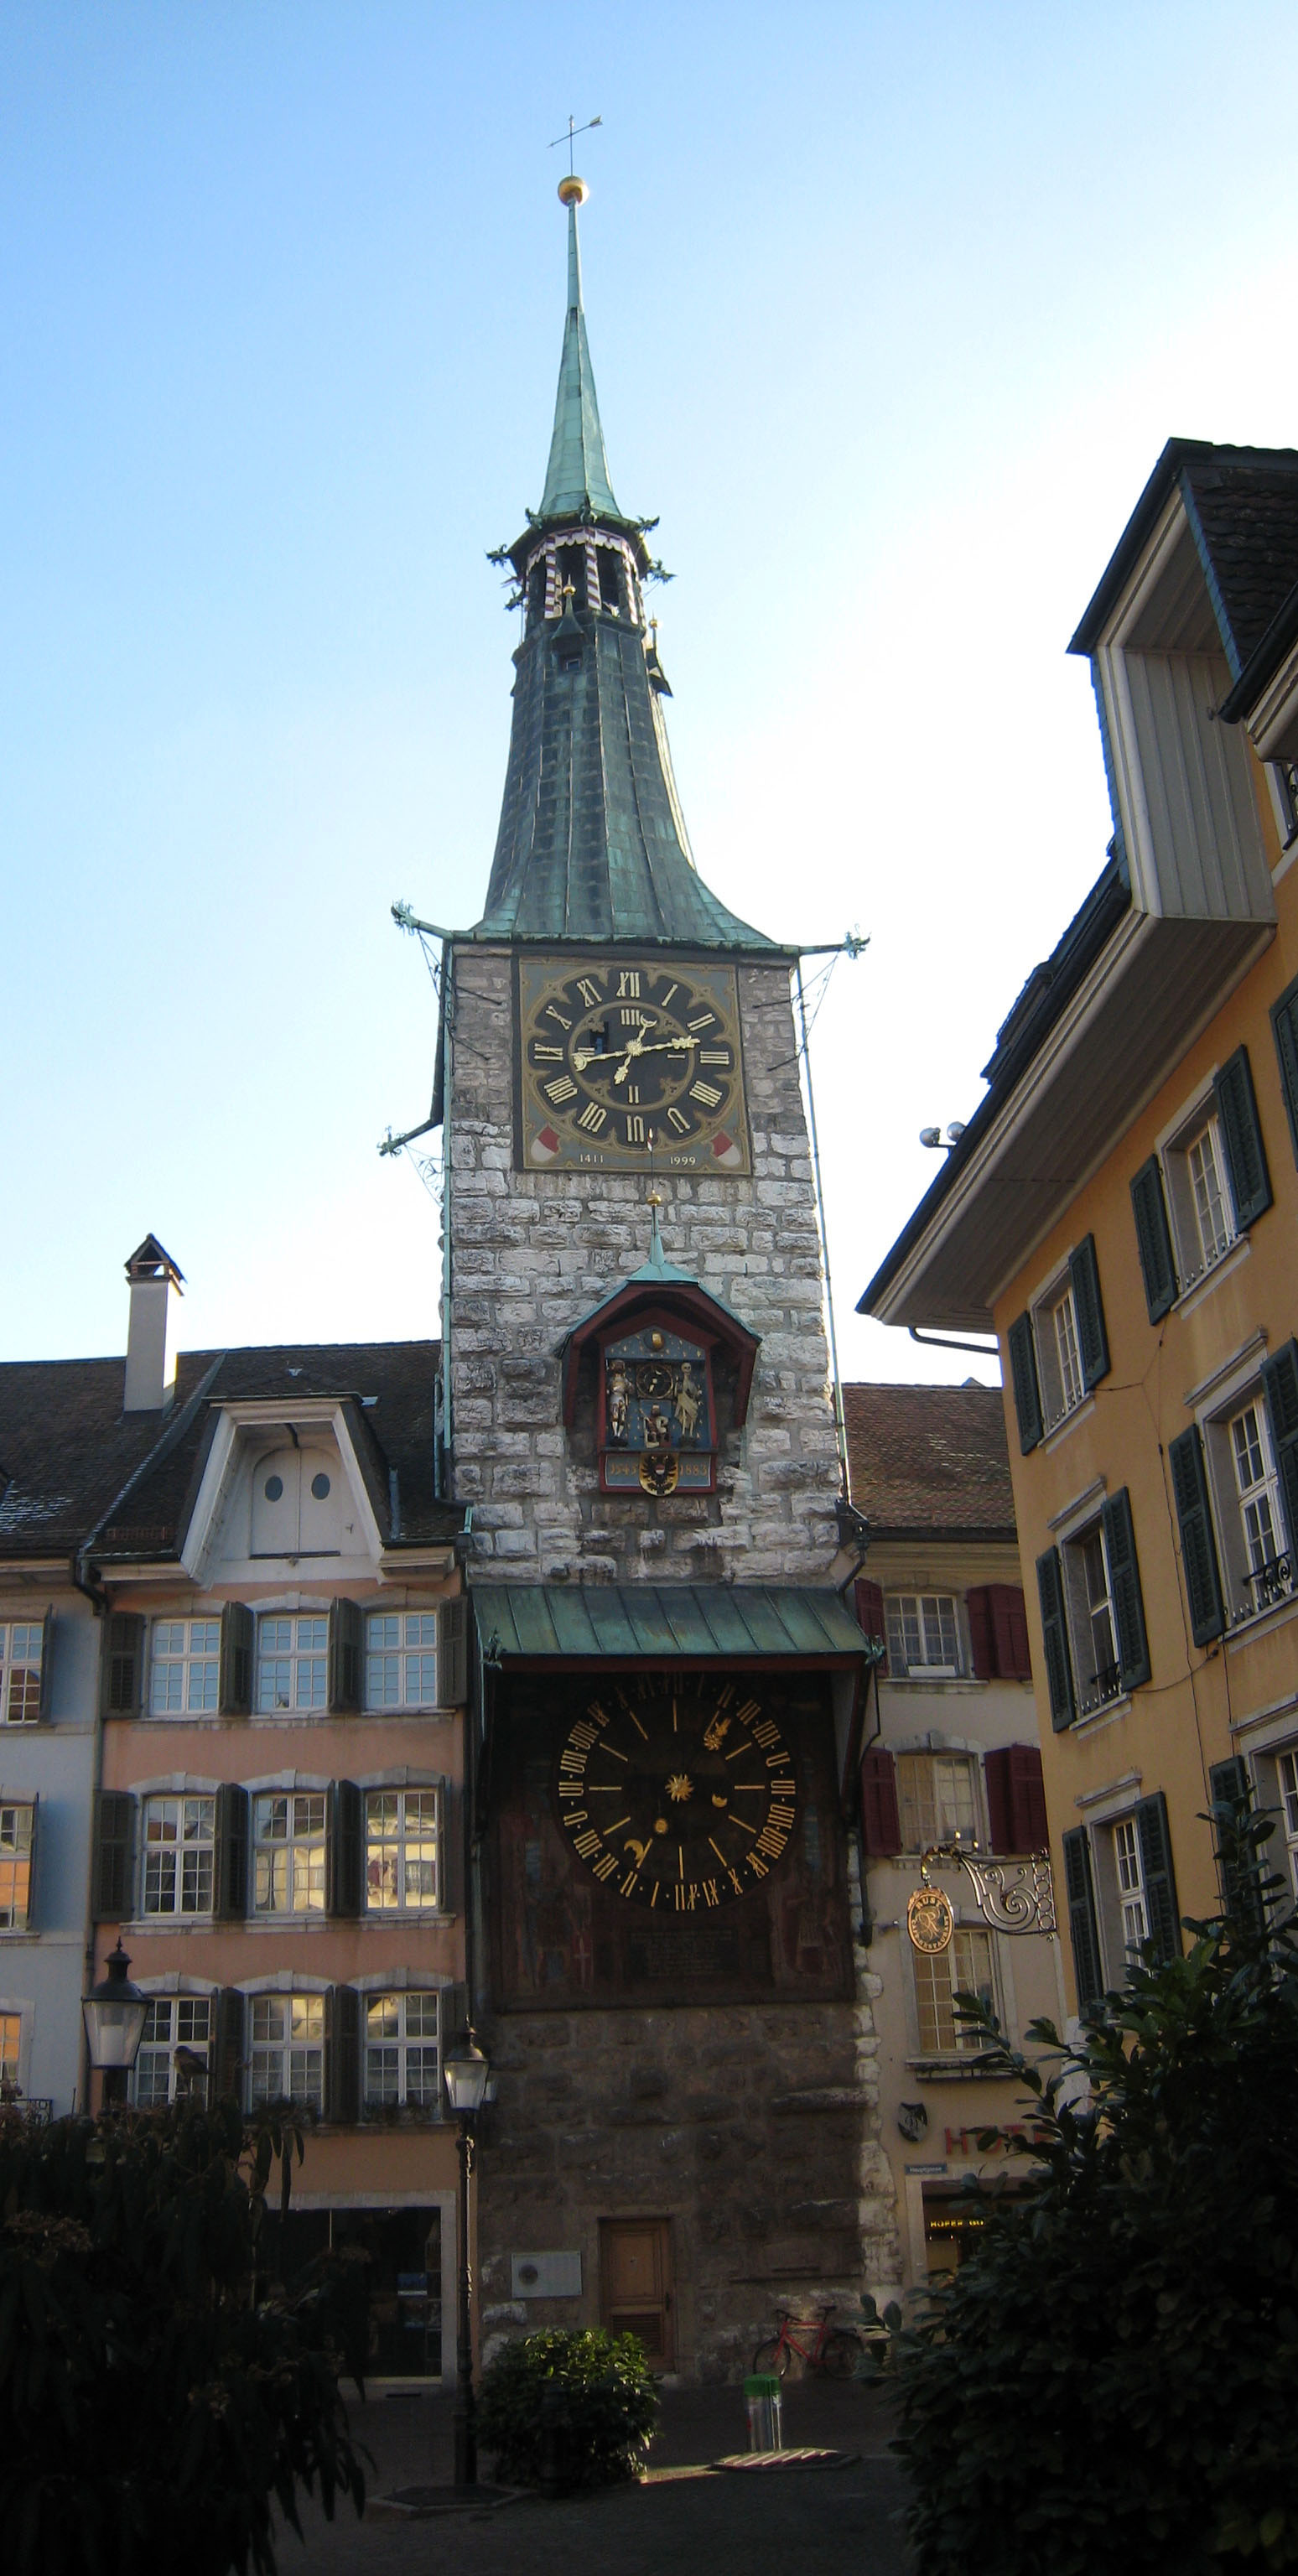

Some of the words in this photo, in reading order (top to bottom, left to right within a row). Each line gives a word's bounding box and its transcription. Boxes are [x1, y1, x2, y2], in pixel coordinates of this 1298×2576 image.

[577, 979, 602, 1007] XI
[616, 971, 639, 998] XII
[662, 984, 678, 1006] I
[546, 1006, 572, 1030] X
[688, 1013, 715, 1031] II
[534, 1043, 563, 1061] IX
[700, 1051, 729, 1065] III
[629, 1086, 639, 1104] II
[689, 1081, 722, 1108] IIII
[579, 1153, 604, 1163] 1411
[670, 1156, 696, 1166] 1999
[945, 2124, 1051, 2155] HOT
